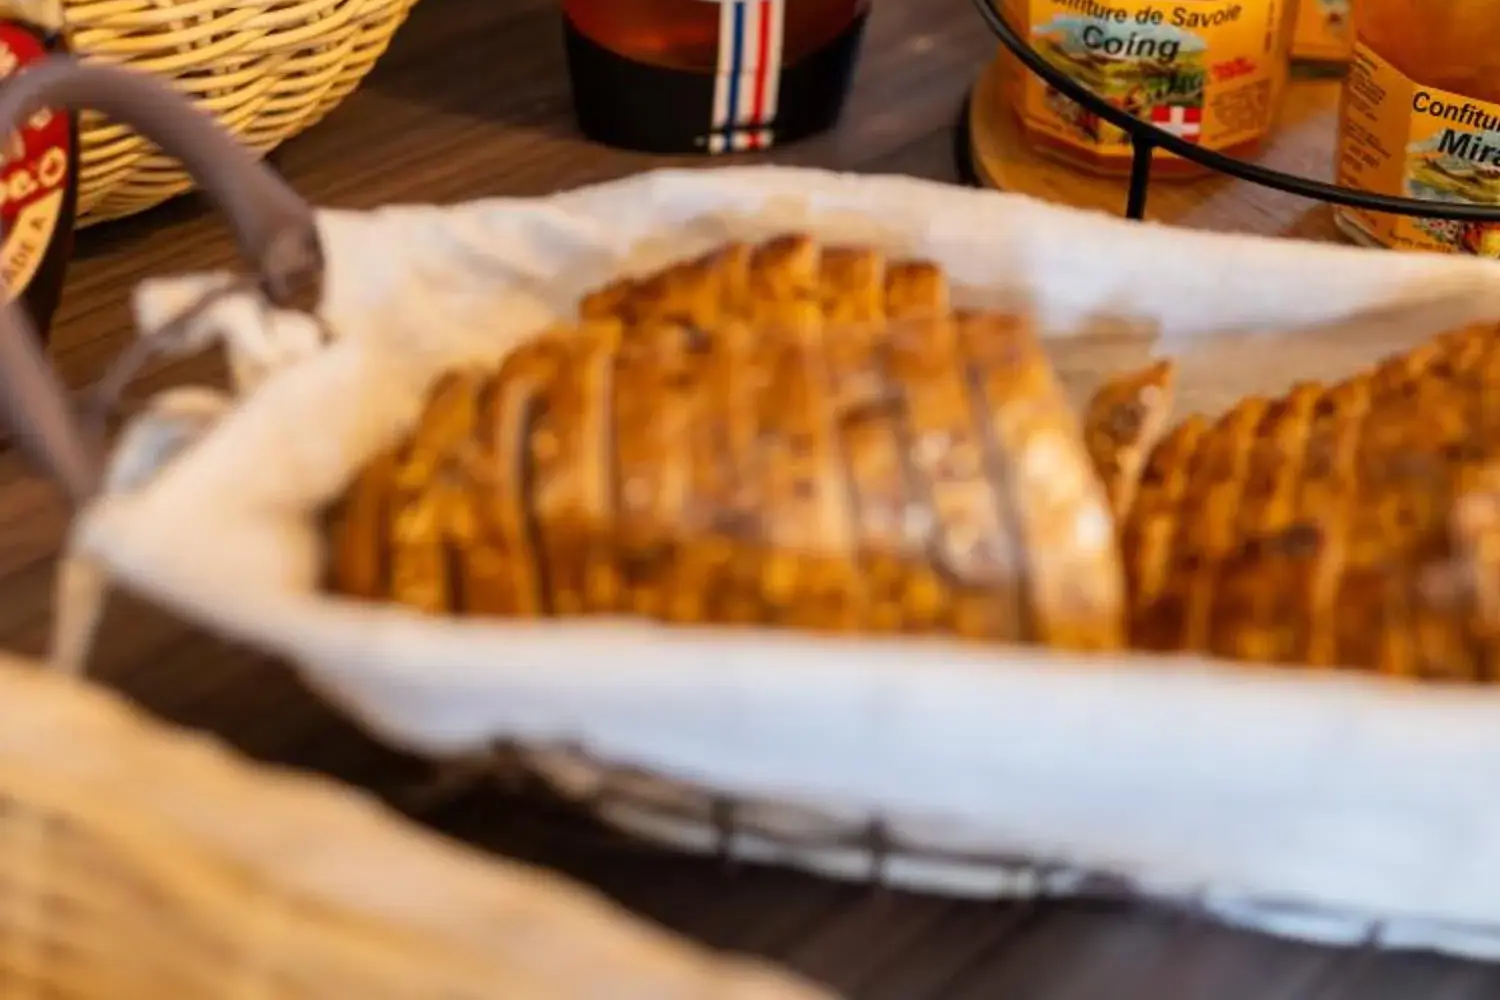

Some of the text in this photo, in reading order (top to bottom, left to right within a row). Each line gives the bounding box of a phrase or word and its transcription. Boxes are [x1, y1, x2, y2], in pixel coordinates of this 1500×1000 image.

[1135, 4, 1164, 26] de
[1171, 3, 1242, 29] Savoie
[1083, 25, 1181, 65] Coing
